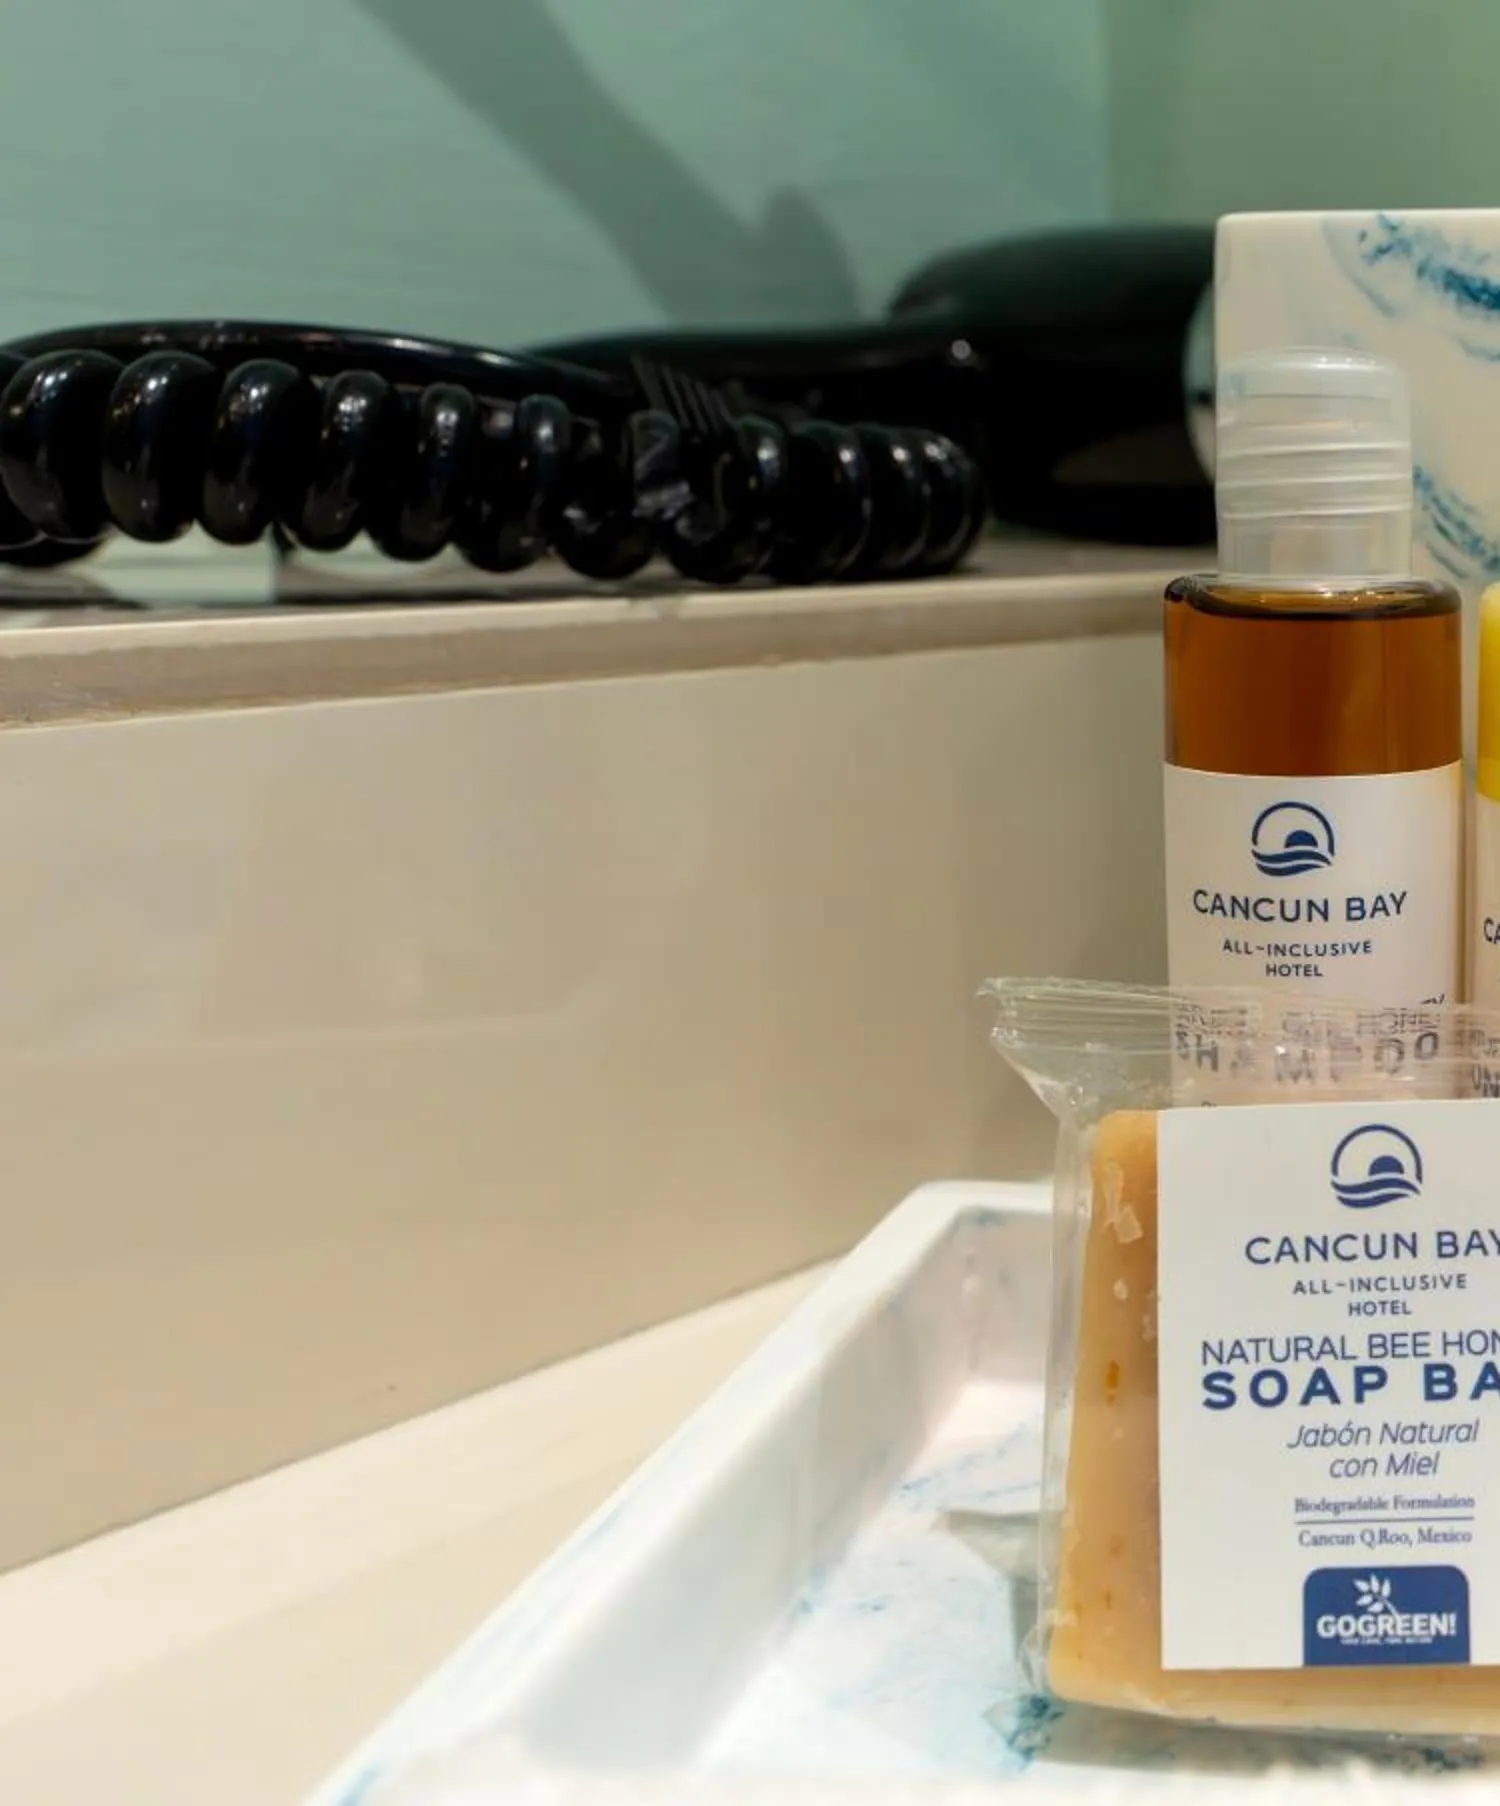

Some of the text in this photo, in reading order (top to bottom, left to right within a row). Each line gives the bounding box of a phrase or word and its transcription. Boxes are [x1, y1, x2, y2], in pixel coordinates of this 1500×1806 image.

[1193, 889, 1407, 922] CANCUN BAY
[1265, 964, 1323, 977] HOTEL
[1245, 1232, 1418, 1265] CANCUN
[1348, 1300, 1411, 1316] HOTEL
[1201, 1336, 1358, 1365] NATURAL
[1368, 1332, 1430, 1358] BEE
[1202, 1365, 1388, 1410] SOAP
[1287, 1418, 1479, 1448] Jabón Natural
[1329, 1451, 1440, 1479] con Miel
[1294, 1493, 1475, 1515] Biodegradable Formulation
[1298, 1529, 1355, 1547] Cancun
[1417, 1526, 1472, 1544] Mexico
[1316, 1611, 1457, 1639] GOGREEN!
